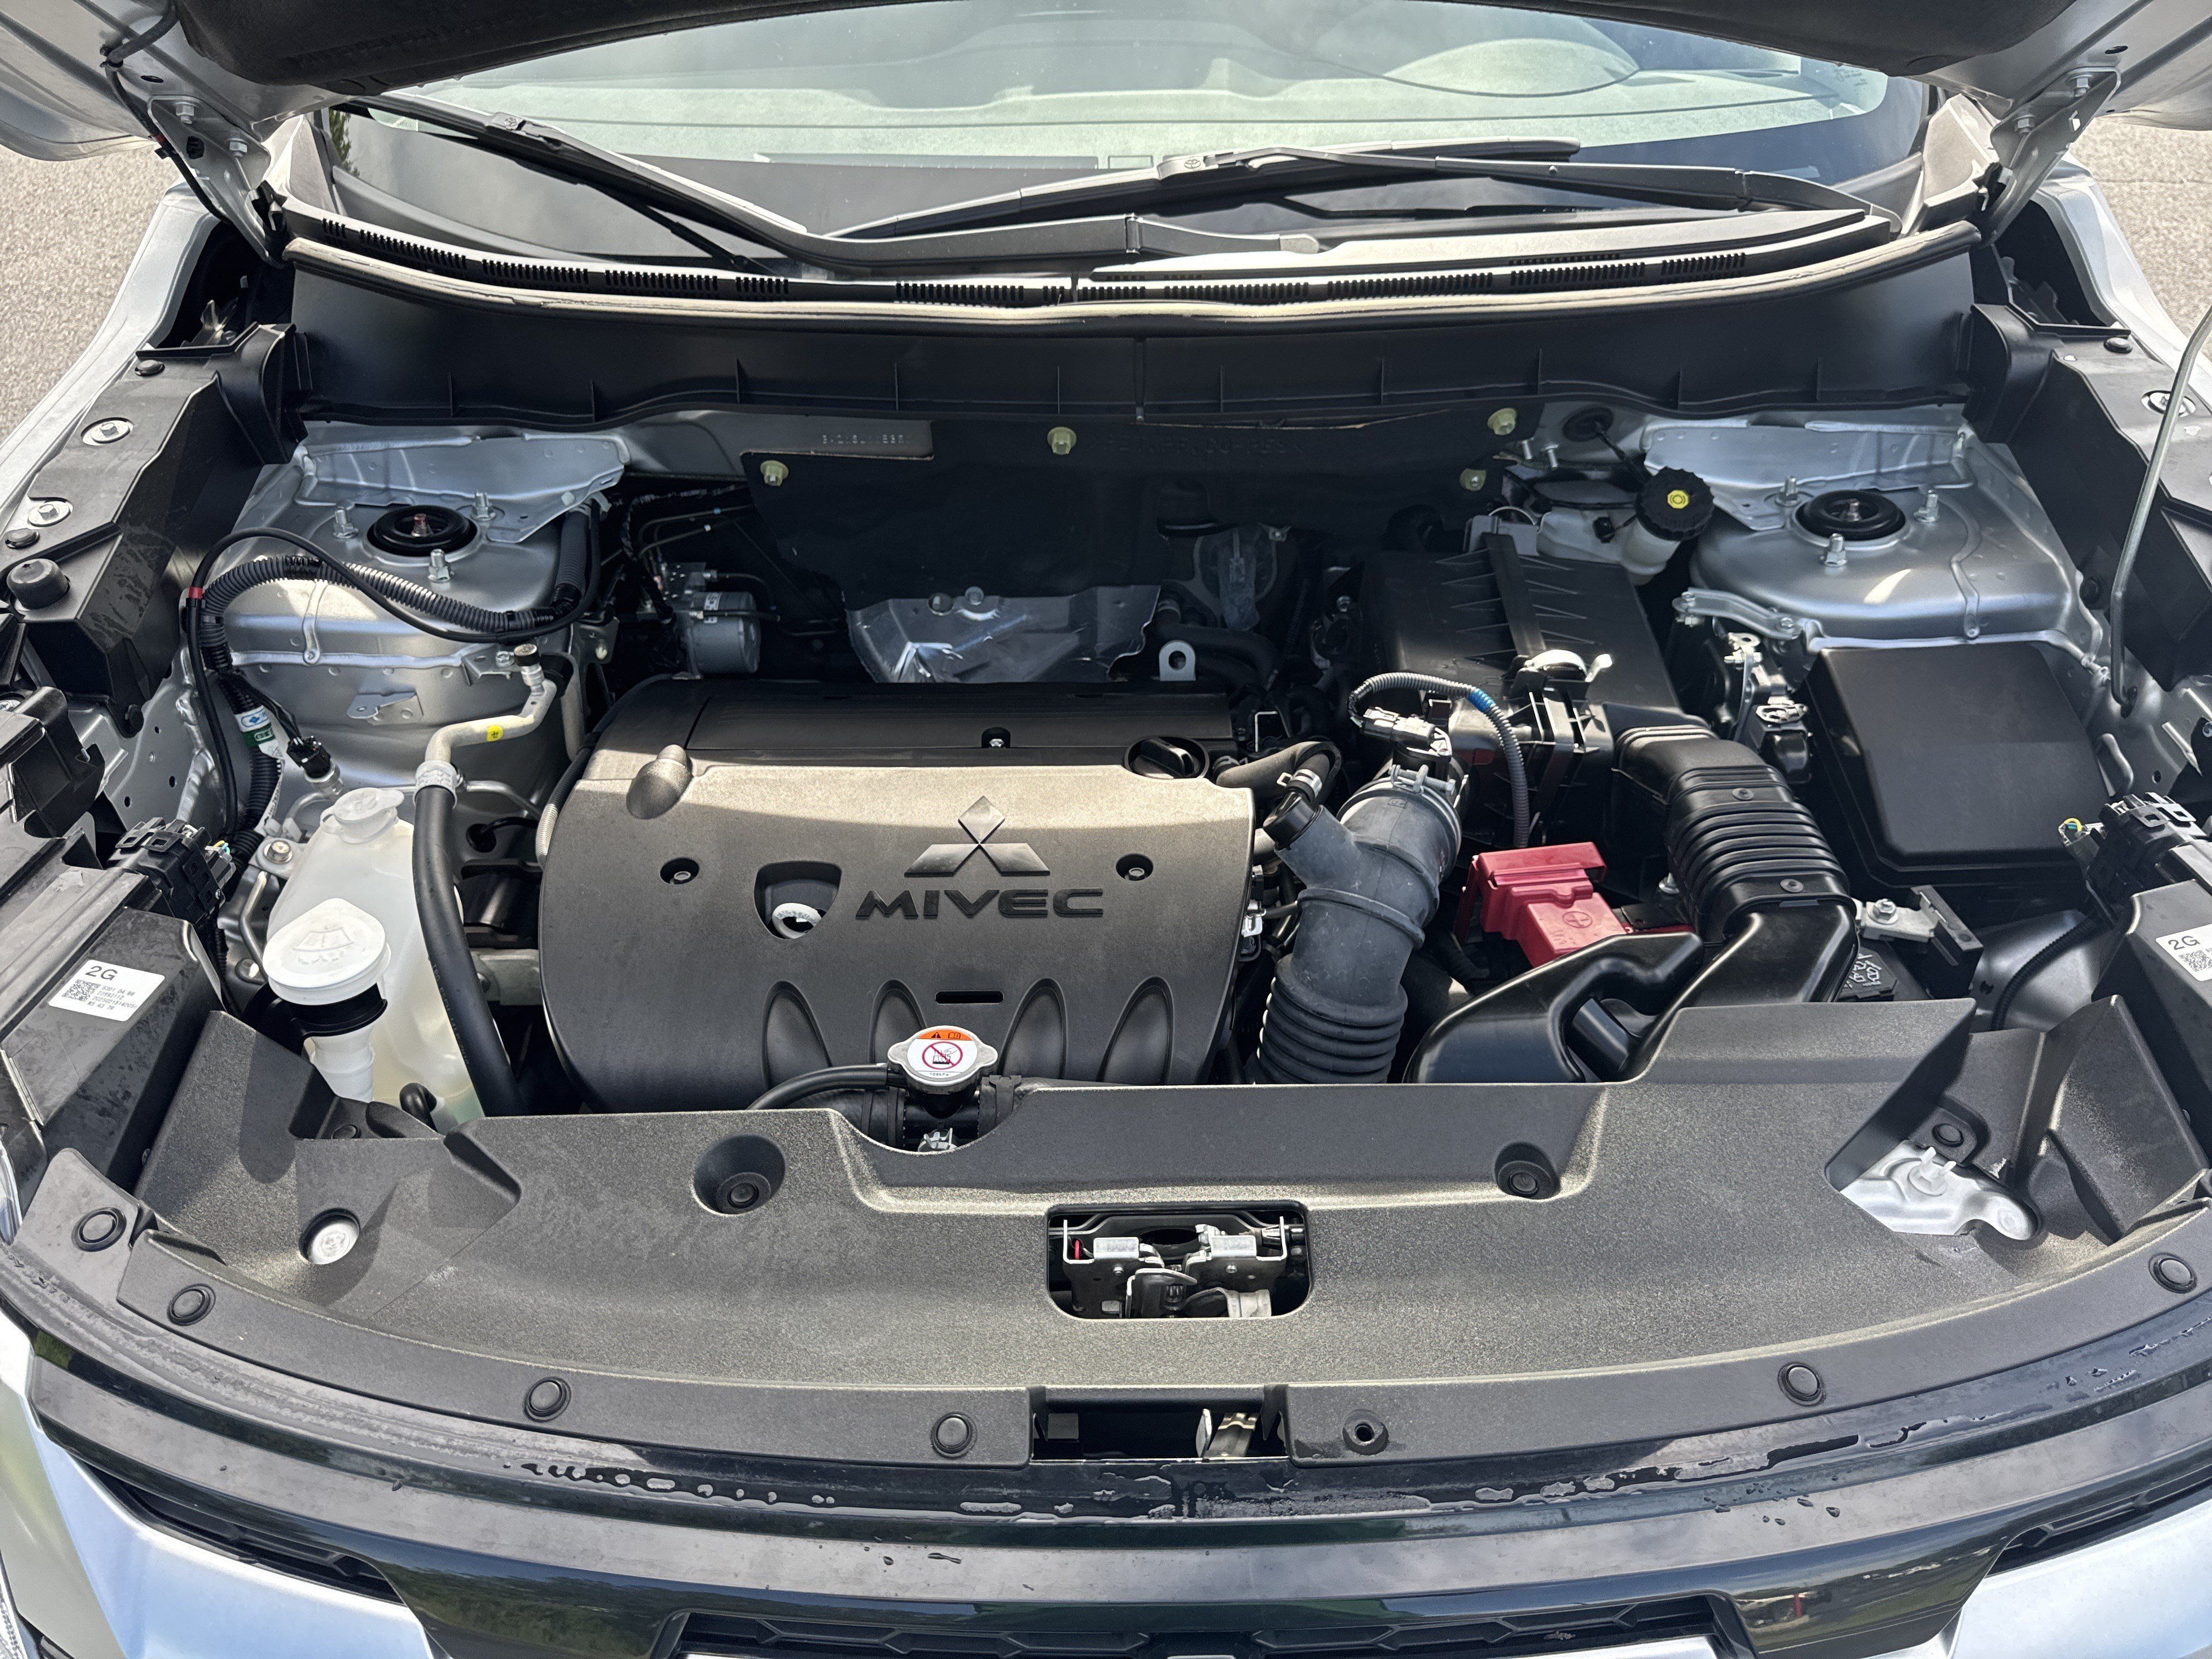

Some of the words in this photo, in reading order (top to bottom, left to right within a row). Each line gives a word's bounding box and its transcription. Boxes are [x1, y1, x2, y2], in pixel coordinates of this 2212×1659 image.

[855, 888, 1104, 919] MIVEC
[2168, 935, 2200, 950] 2G
[84, 966, 118, 981] 2G
